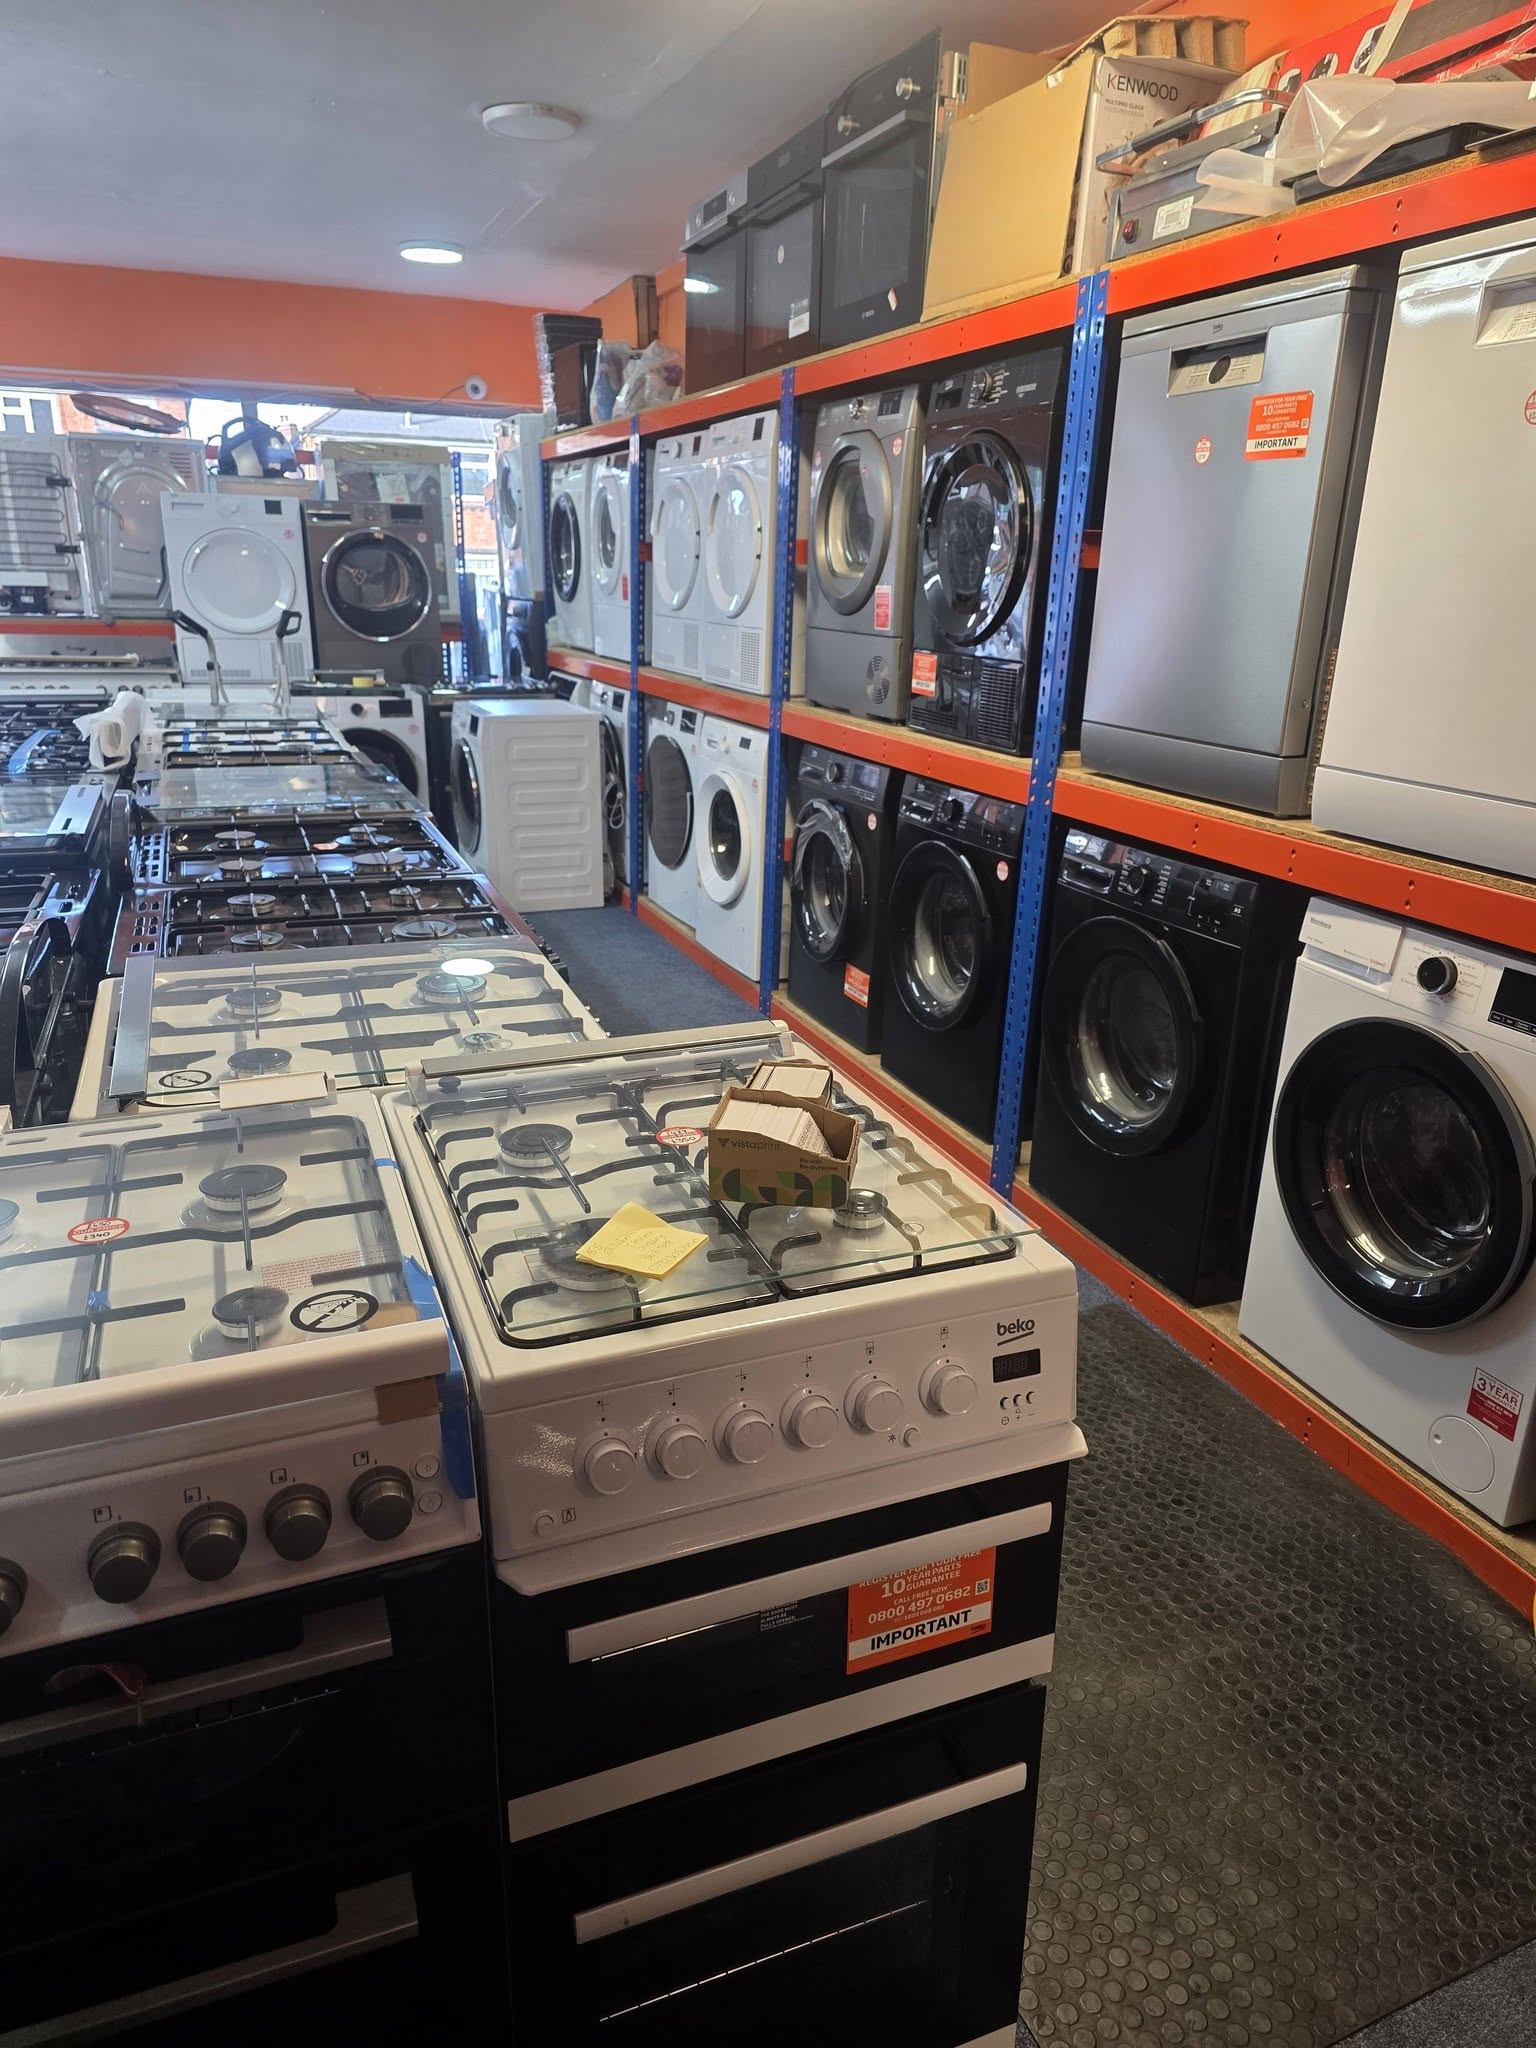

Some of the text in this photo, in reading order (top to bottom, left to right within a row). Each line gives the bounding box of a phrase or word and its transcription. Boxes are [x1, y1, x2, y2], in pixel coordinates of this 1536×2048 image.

[1107, 73, 1178, 101] KENWOOD
[1262, 405, 1274, 416] 10
[1255, 423, 1271, 432] 0800
[1272, 421, 1283, 430] 497
[1283, 420, 1300, 429] 0682
[1254, 437, 1298, 449] IMPORTANT
[730, 1137, 781, 1150] vistaprint
[800, 1164, 839, 1172] Re-purpose
[84, 1232, 110, 1240] £340
[996, 1318, 1035, 1336] beko
[1477, 1377, 1487, 1391] 3
[1489, 1382, 1519, 1407] YEAR
[859, 1571, 907, 1588] REGISTER
[906, 1570, 961, 1591] GUARANTEE
[907, 1562, 962, 1582] YEAR PARTS
[881, 1578, 906, 1598] 10
[868, 1605, 905, 1624] 0800
[908, 1598, 933, 1613] 497
[936, 1586, 971, 1604] 0682
[894, 1595, 912, 1605] CALL
[912, 1589, 931, 1600] FREE
[871, 1609, 972, 1650] IMPORTANT
